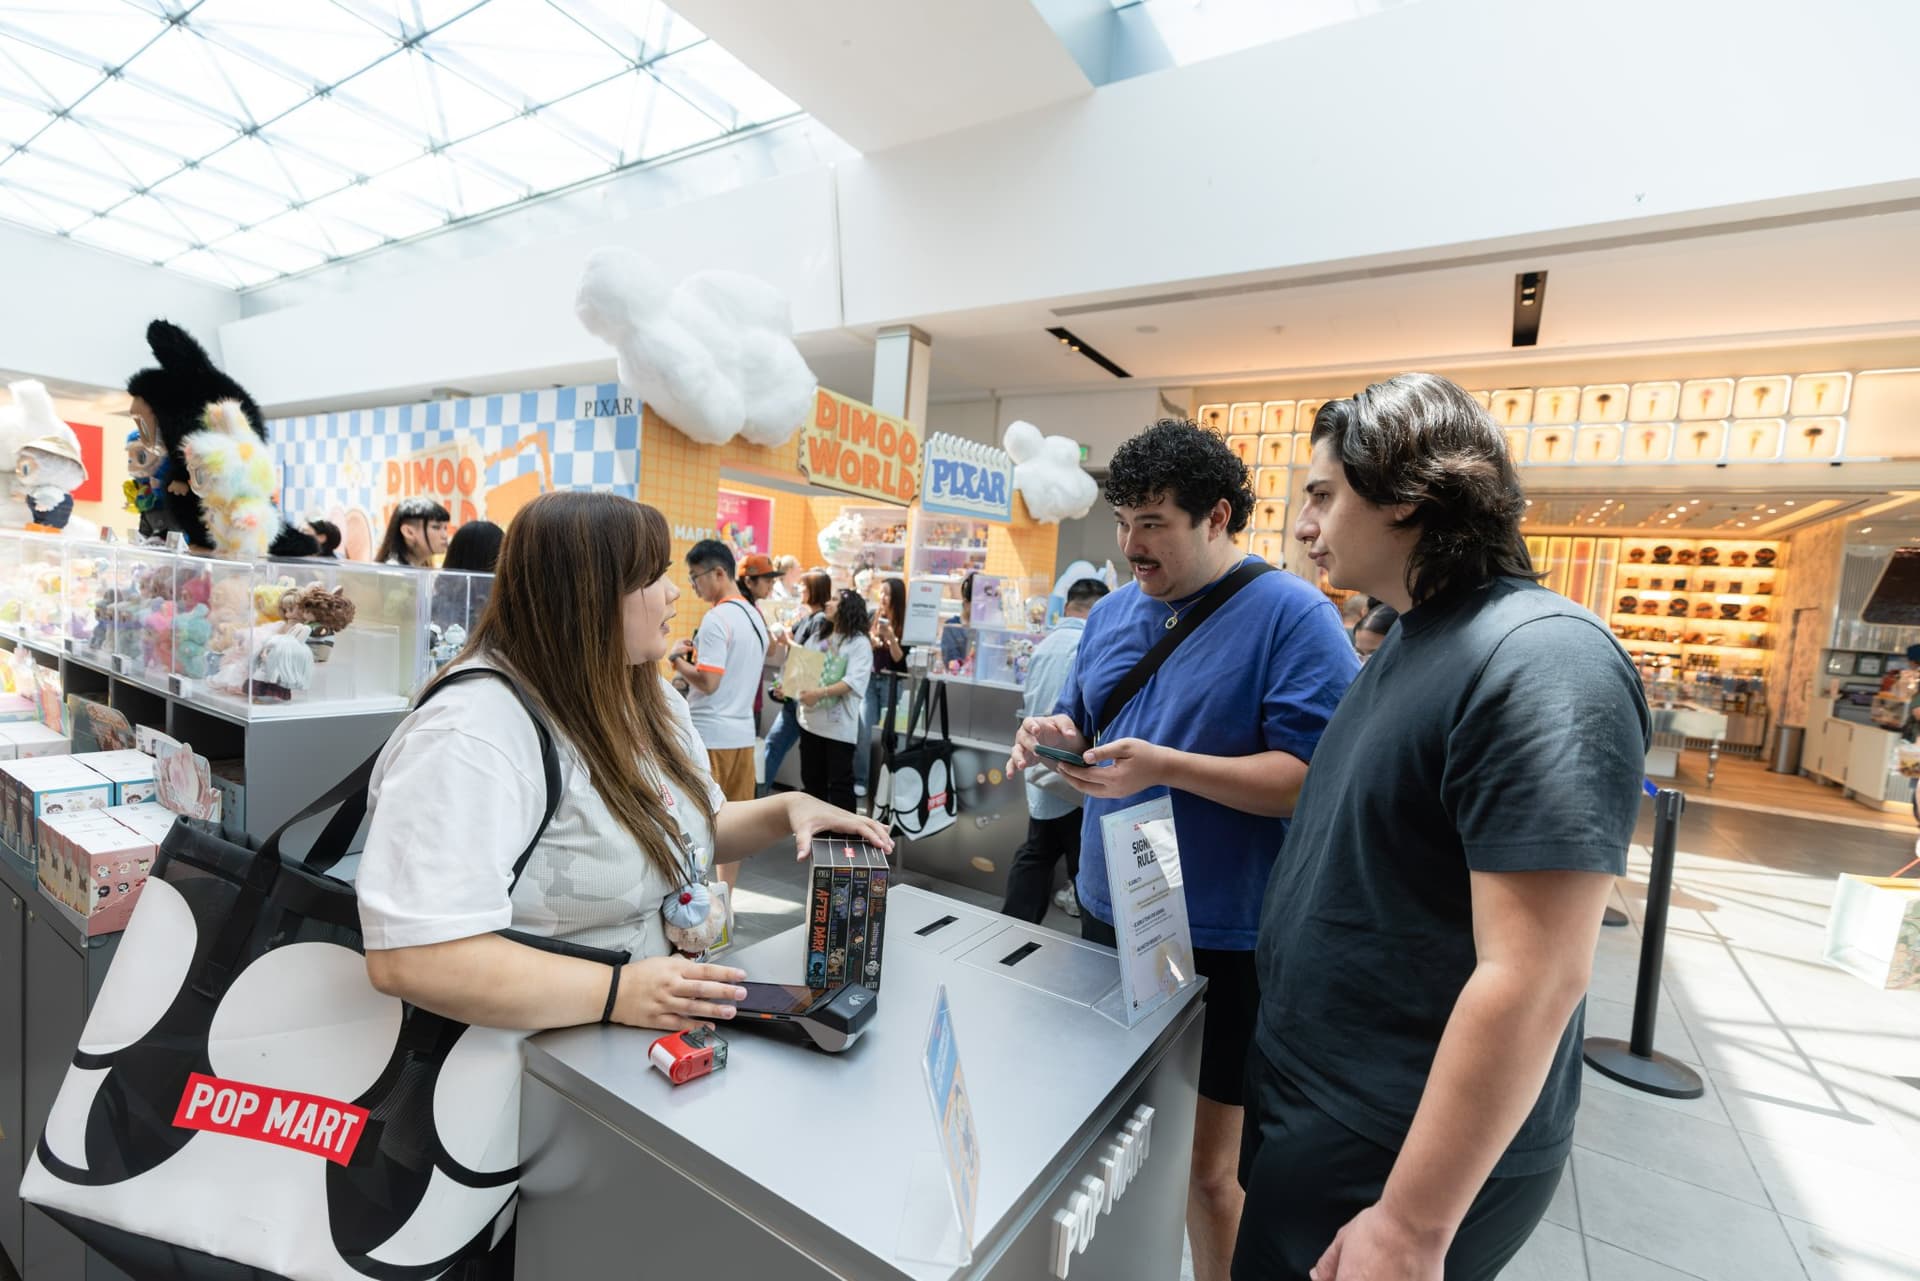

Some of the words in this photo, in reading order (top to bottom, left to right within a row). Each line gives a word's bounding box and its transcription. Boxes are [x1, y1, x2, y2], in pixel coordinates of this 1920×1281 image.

[584, 398, 634, 418] PIXAR
[815, 390, 917, 466] DIMOO
[386, 457, 478, 498] DIMOO
[808, 436, 916, 501] WORLD
[932, 458, 1005, 505] PIXAR
[674, 525, 713, 541] MART
[815, 888, 831, 923] AFTER
[812, 926, 826, 953] DARK
[185, 1082, 260, 1128] POP
[262, 1096, 359, 1153] MART
